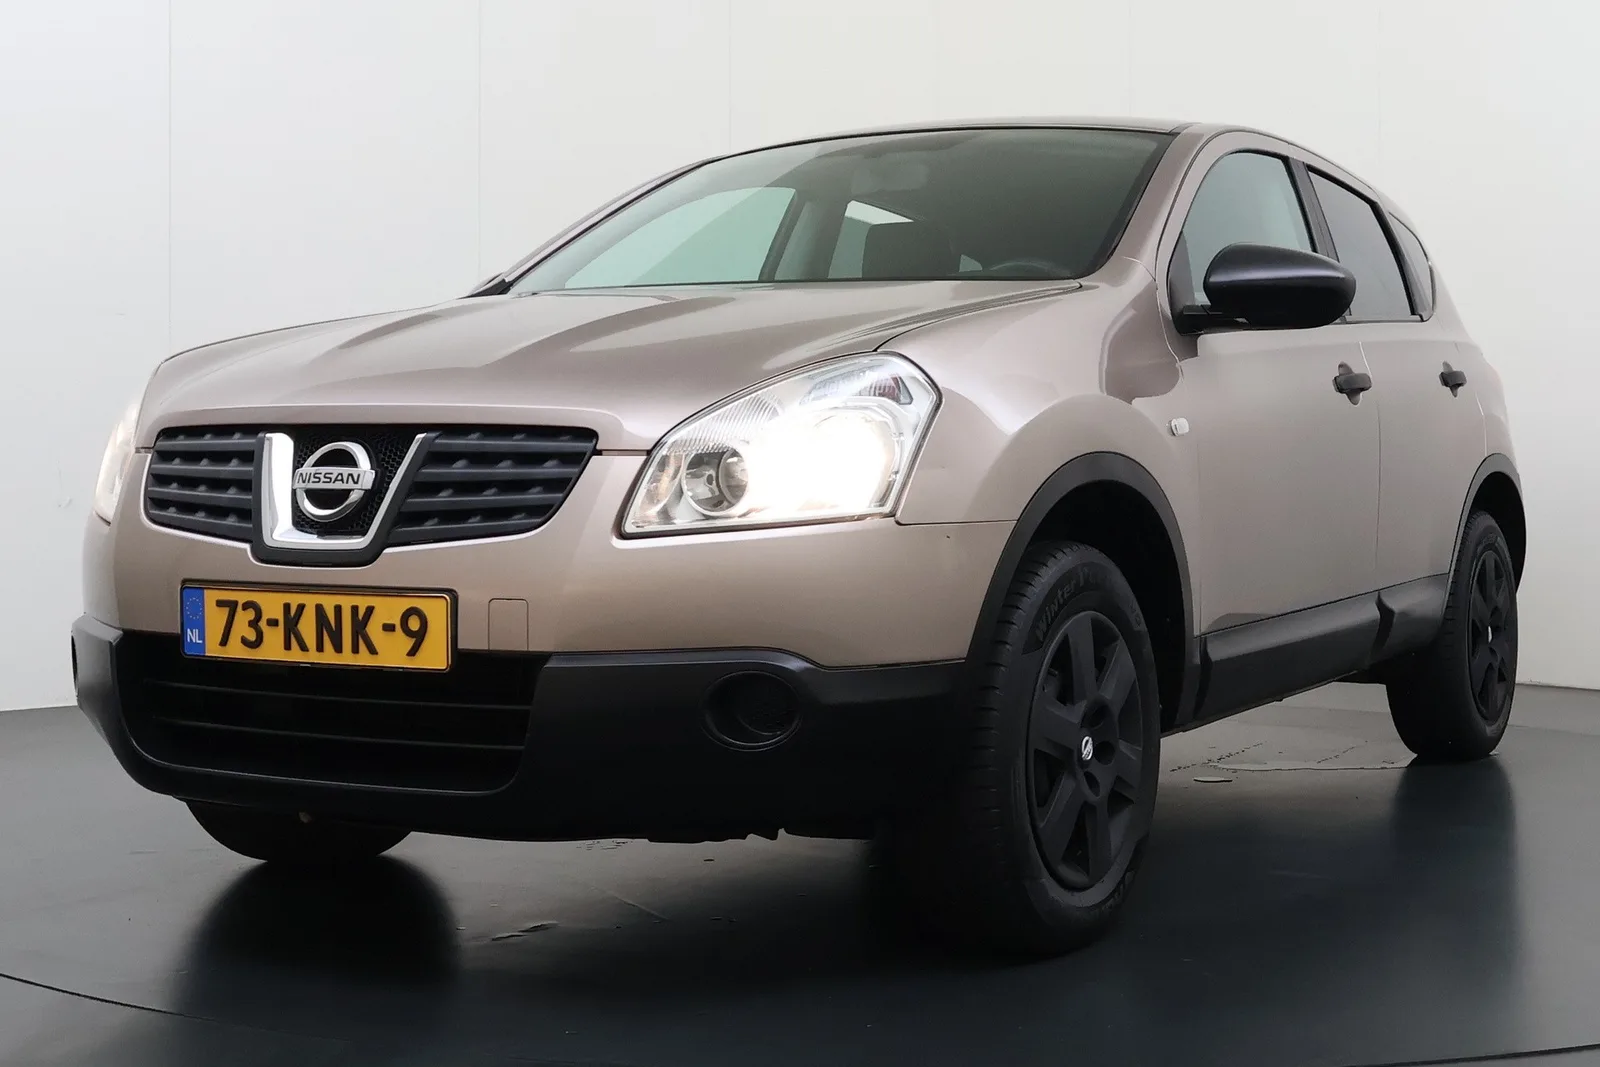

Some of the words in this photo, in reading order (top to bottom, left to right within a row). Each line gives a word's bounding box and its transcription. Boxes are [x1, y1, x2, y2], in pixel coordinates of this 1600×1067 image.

[297, 472, 361, 485] NISSAN
[215, 599, 428, 657] 73-KNK-9
[187, 629, 203, 643] NL
